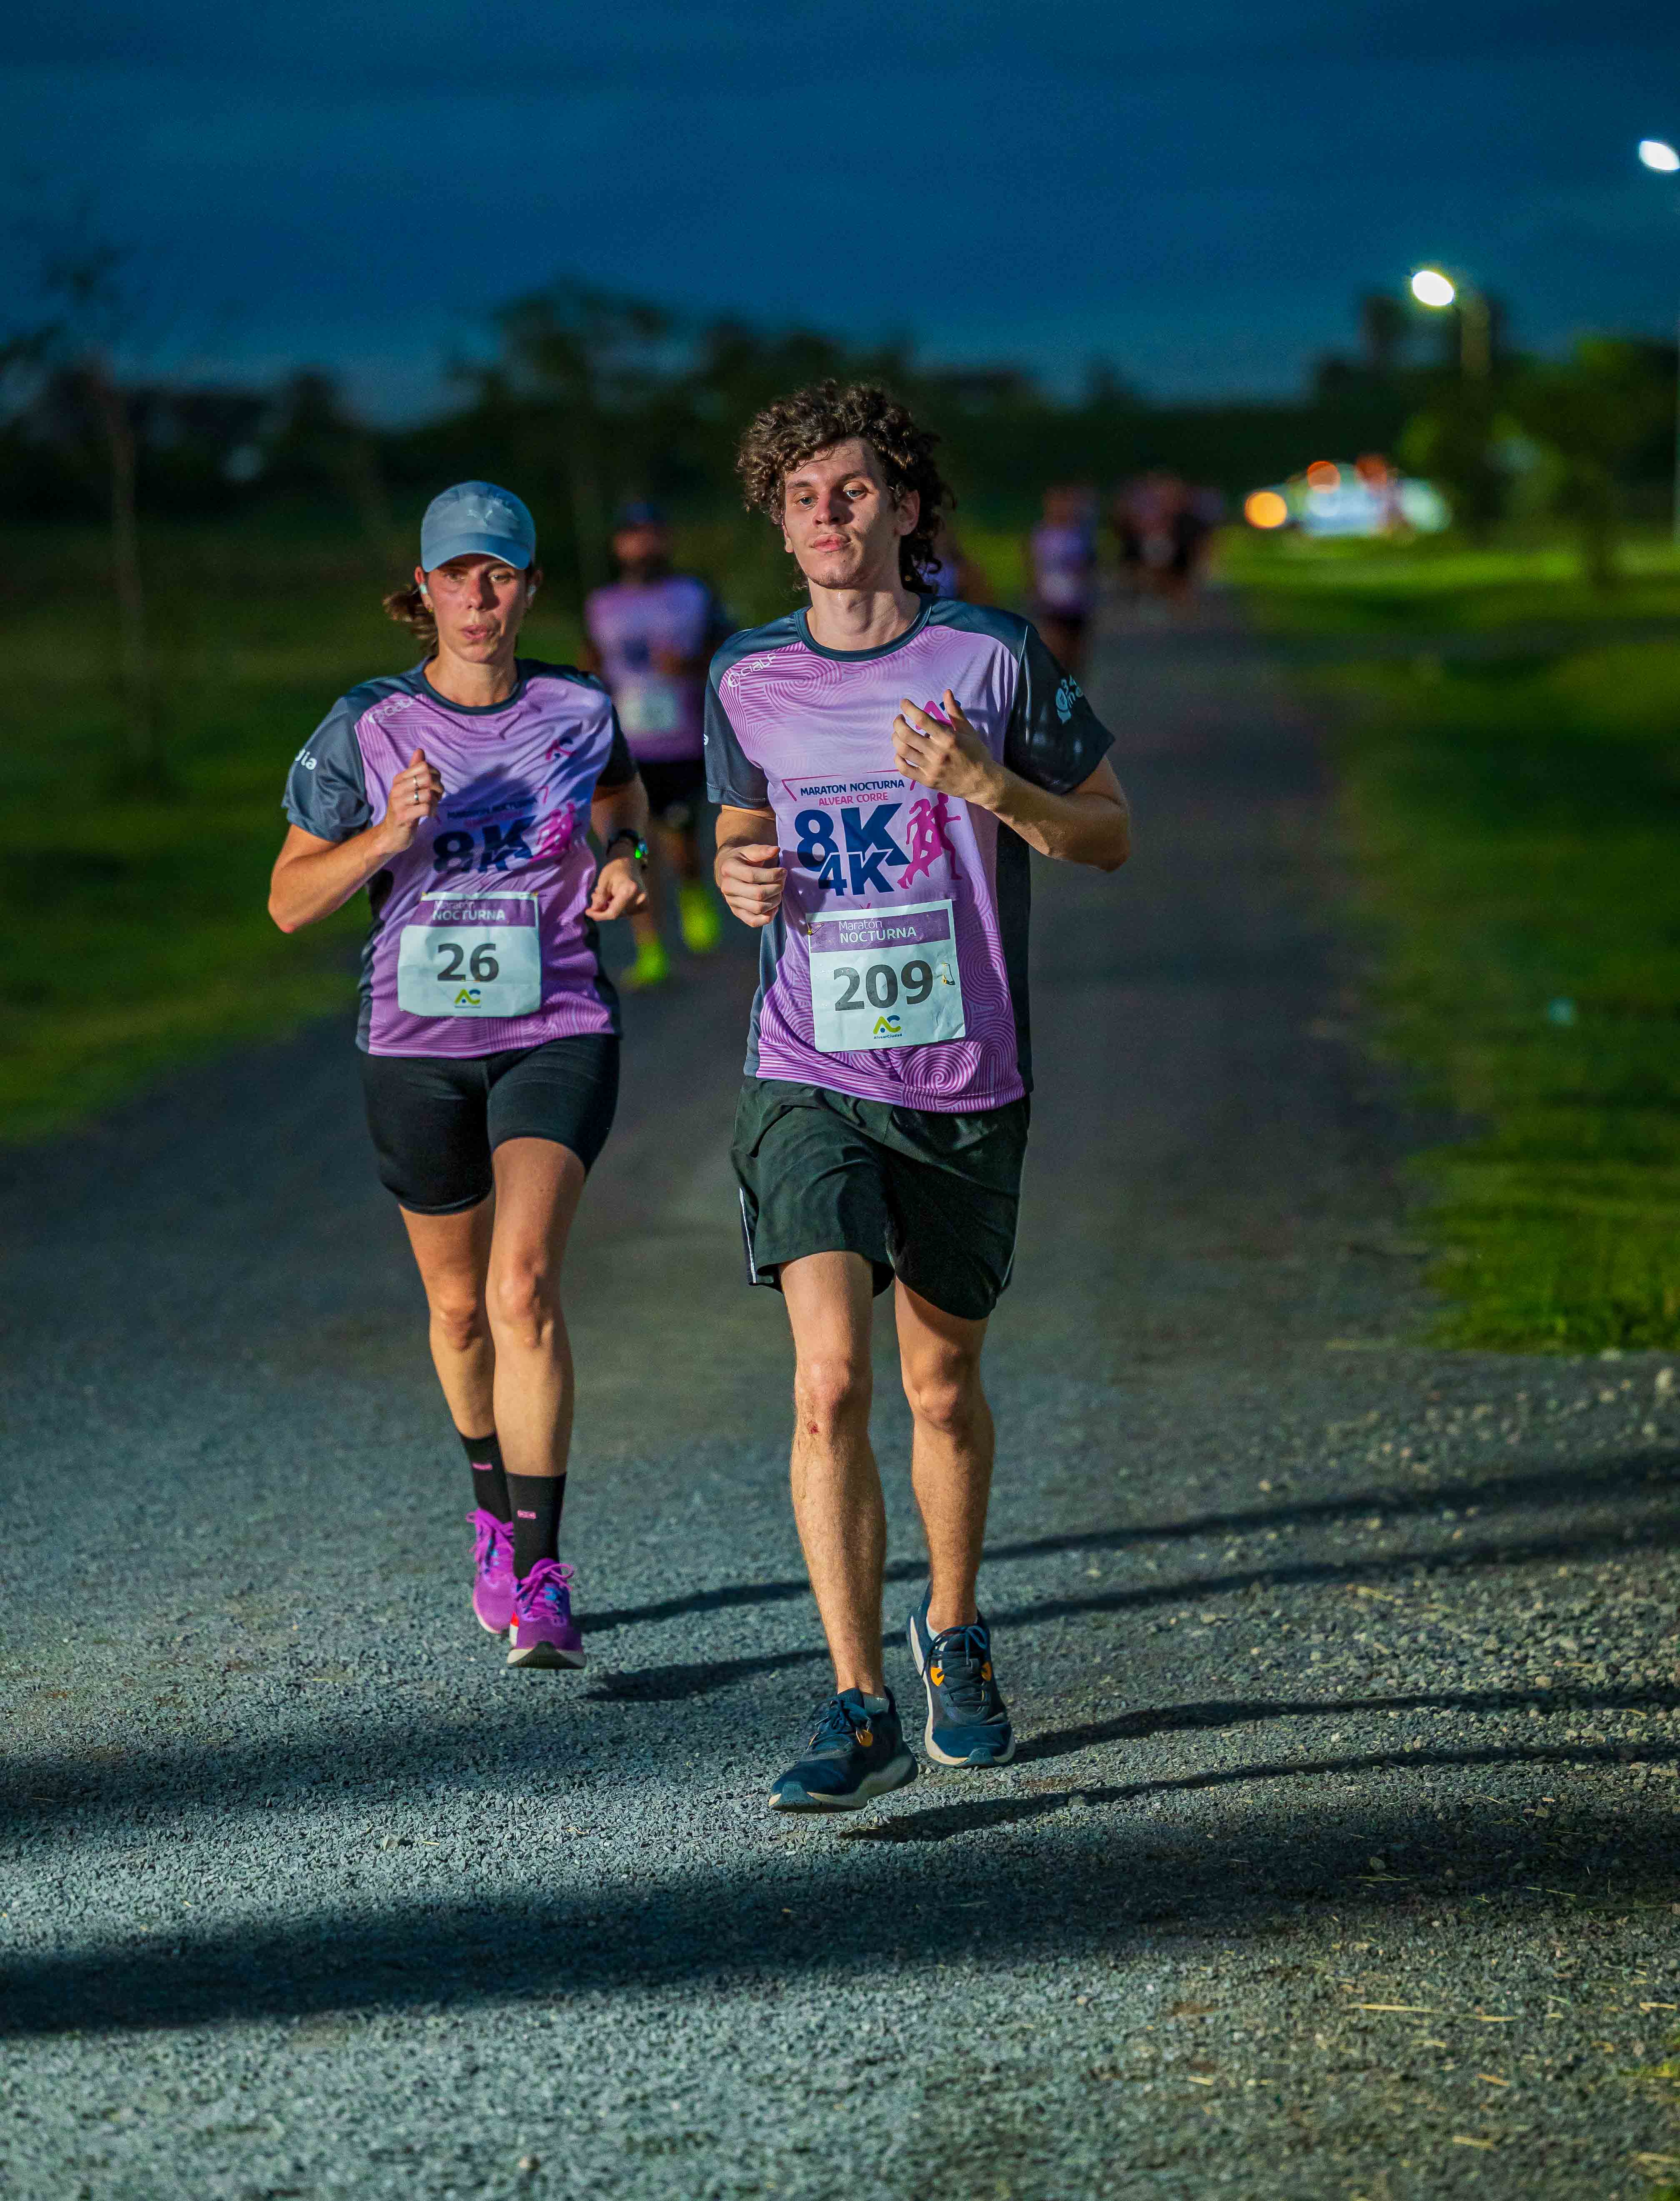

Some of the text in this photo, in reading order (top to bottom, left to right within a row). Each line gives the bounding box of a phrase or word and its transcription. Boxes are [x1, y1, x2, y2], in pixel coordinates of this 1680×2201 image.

[800, 779, 905, 796] MARATON NOCTURNA
[819, 792, 889, 806] ALVEAR CORRE
[795, 803, 912, 872] 8K
[818, 851, 895, 896] 4K
[432, 909, 506, 921] NOCTURNA
[839, 919, 882, 931] Maratón
[839, 926, 917, 944] NOCTURNA
[438, 943, 499, 983] 26
[834, 960, 933, 1011] 209
